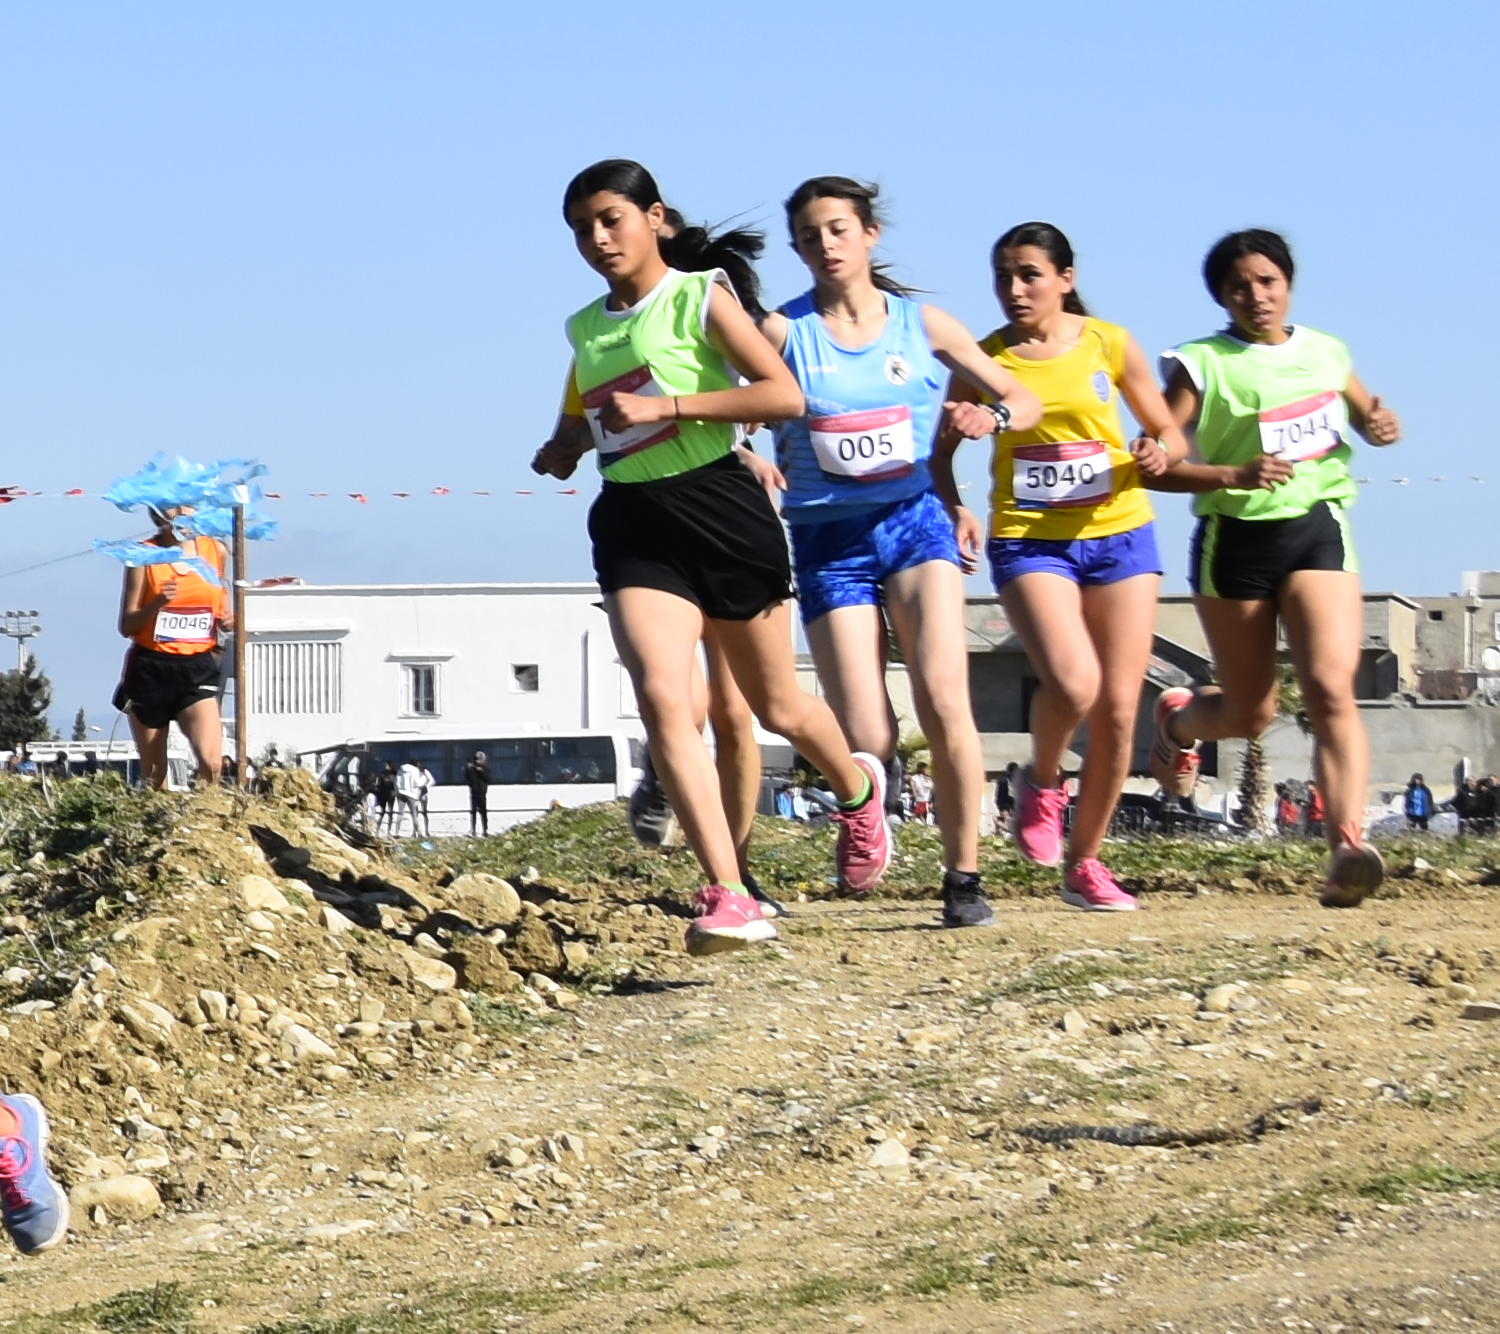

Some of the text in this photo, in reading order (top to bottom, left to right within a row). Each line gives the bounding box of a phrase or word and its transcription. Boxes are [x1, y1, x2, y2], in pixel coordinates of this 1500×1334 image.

[838, 432, 893, 461] 005
[1025, 463, 1094, 488] 5040
[161, 616, 208, 629] 10046
